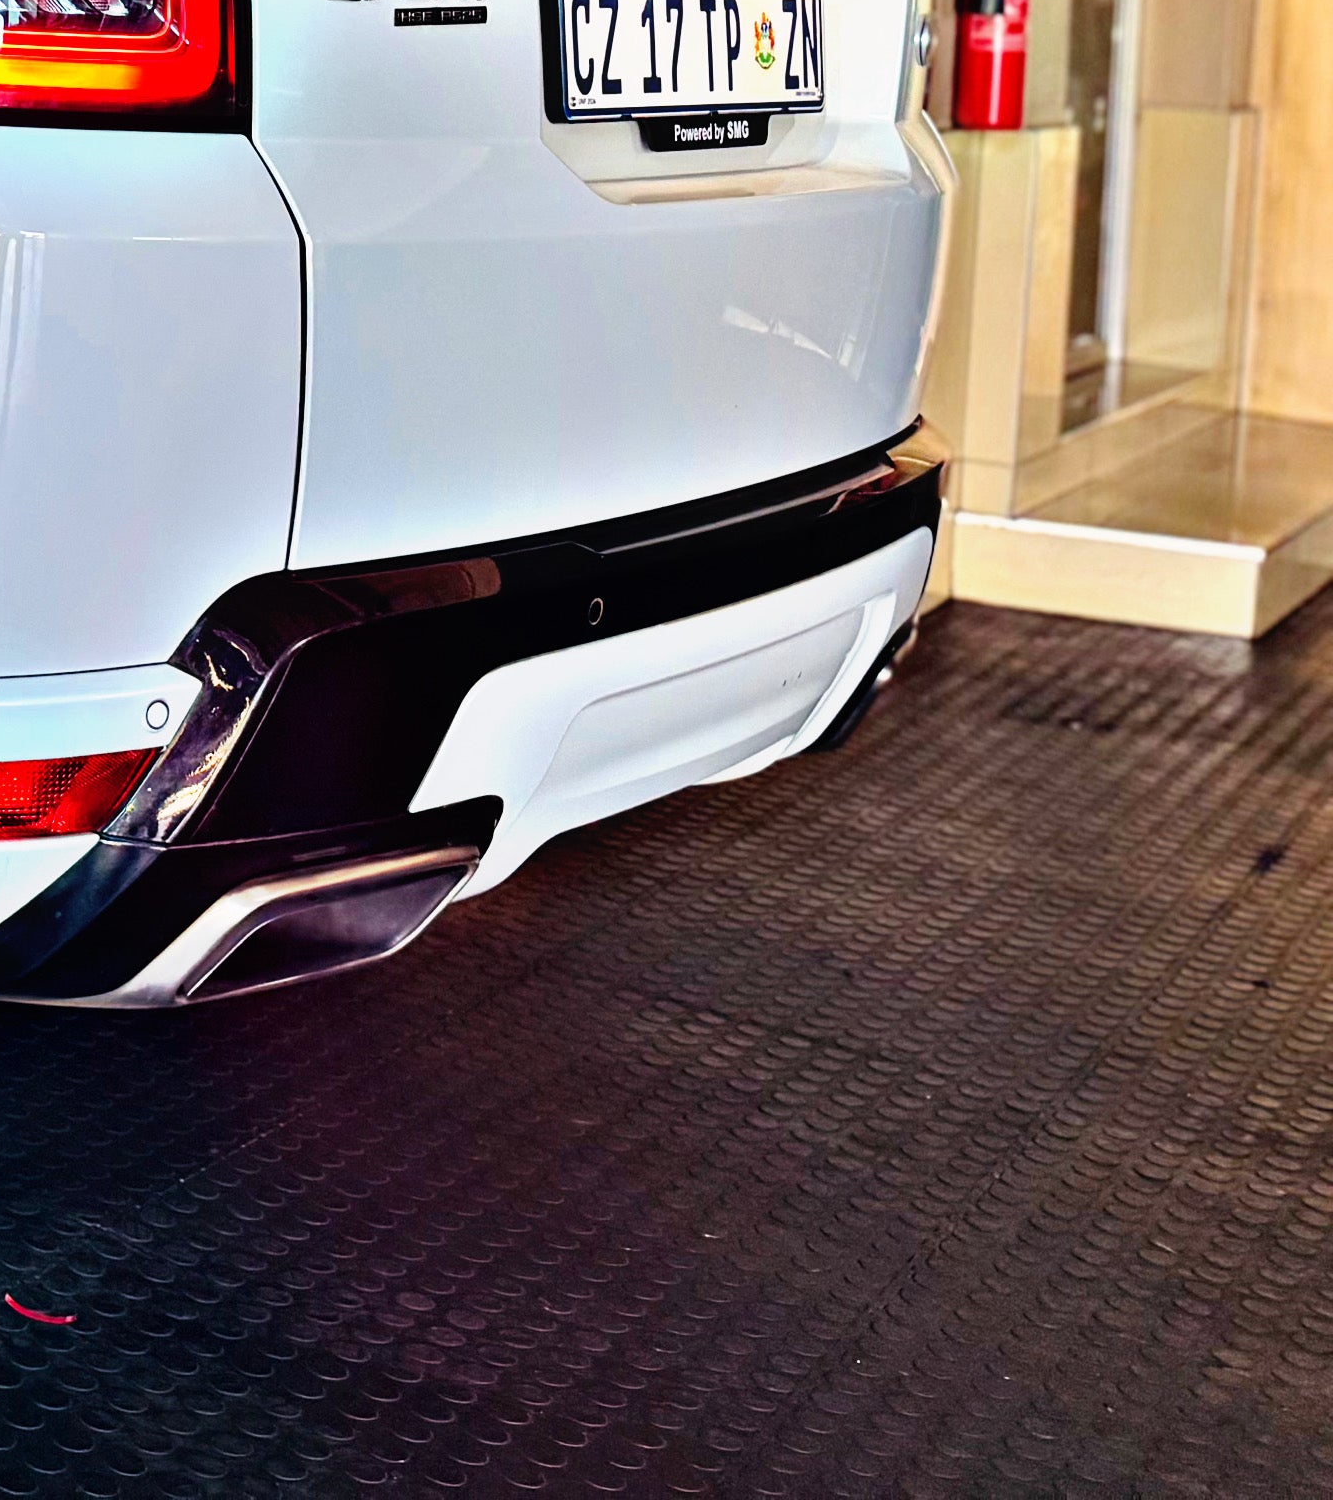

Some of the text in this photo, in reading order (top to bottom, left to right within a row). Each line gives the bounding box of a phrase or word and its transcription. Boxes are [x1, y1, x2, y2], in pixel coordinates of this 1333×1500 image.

[674, 120, 750, 144] Powered by SMG
